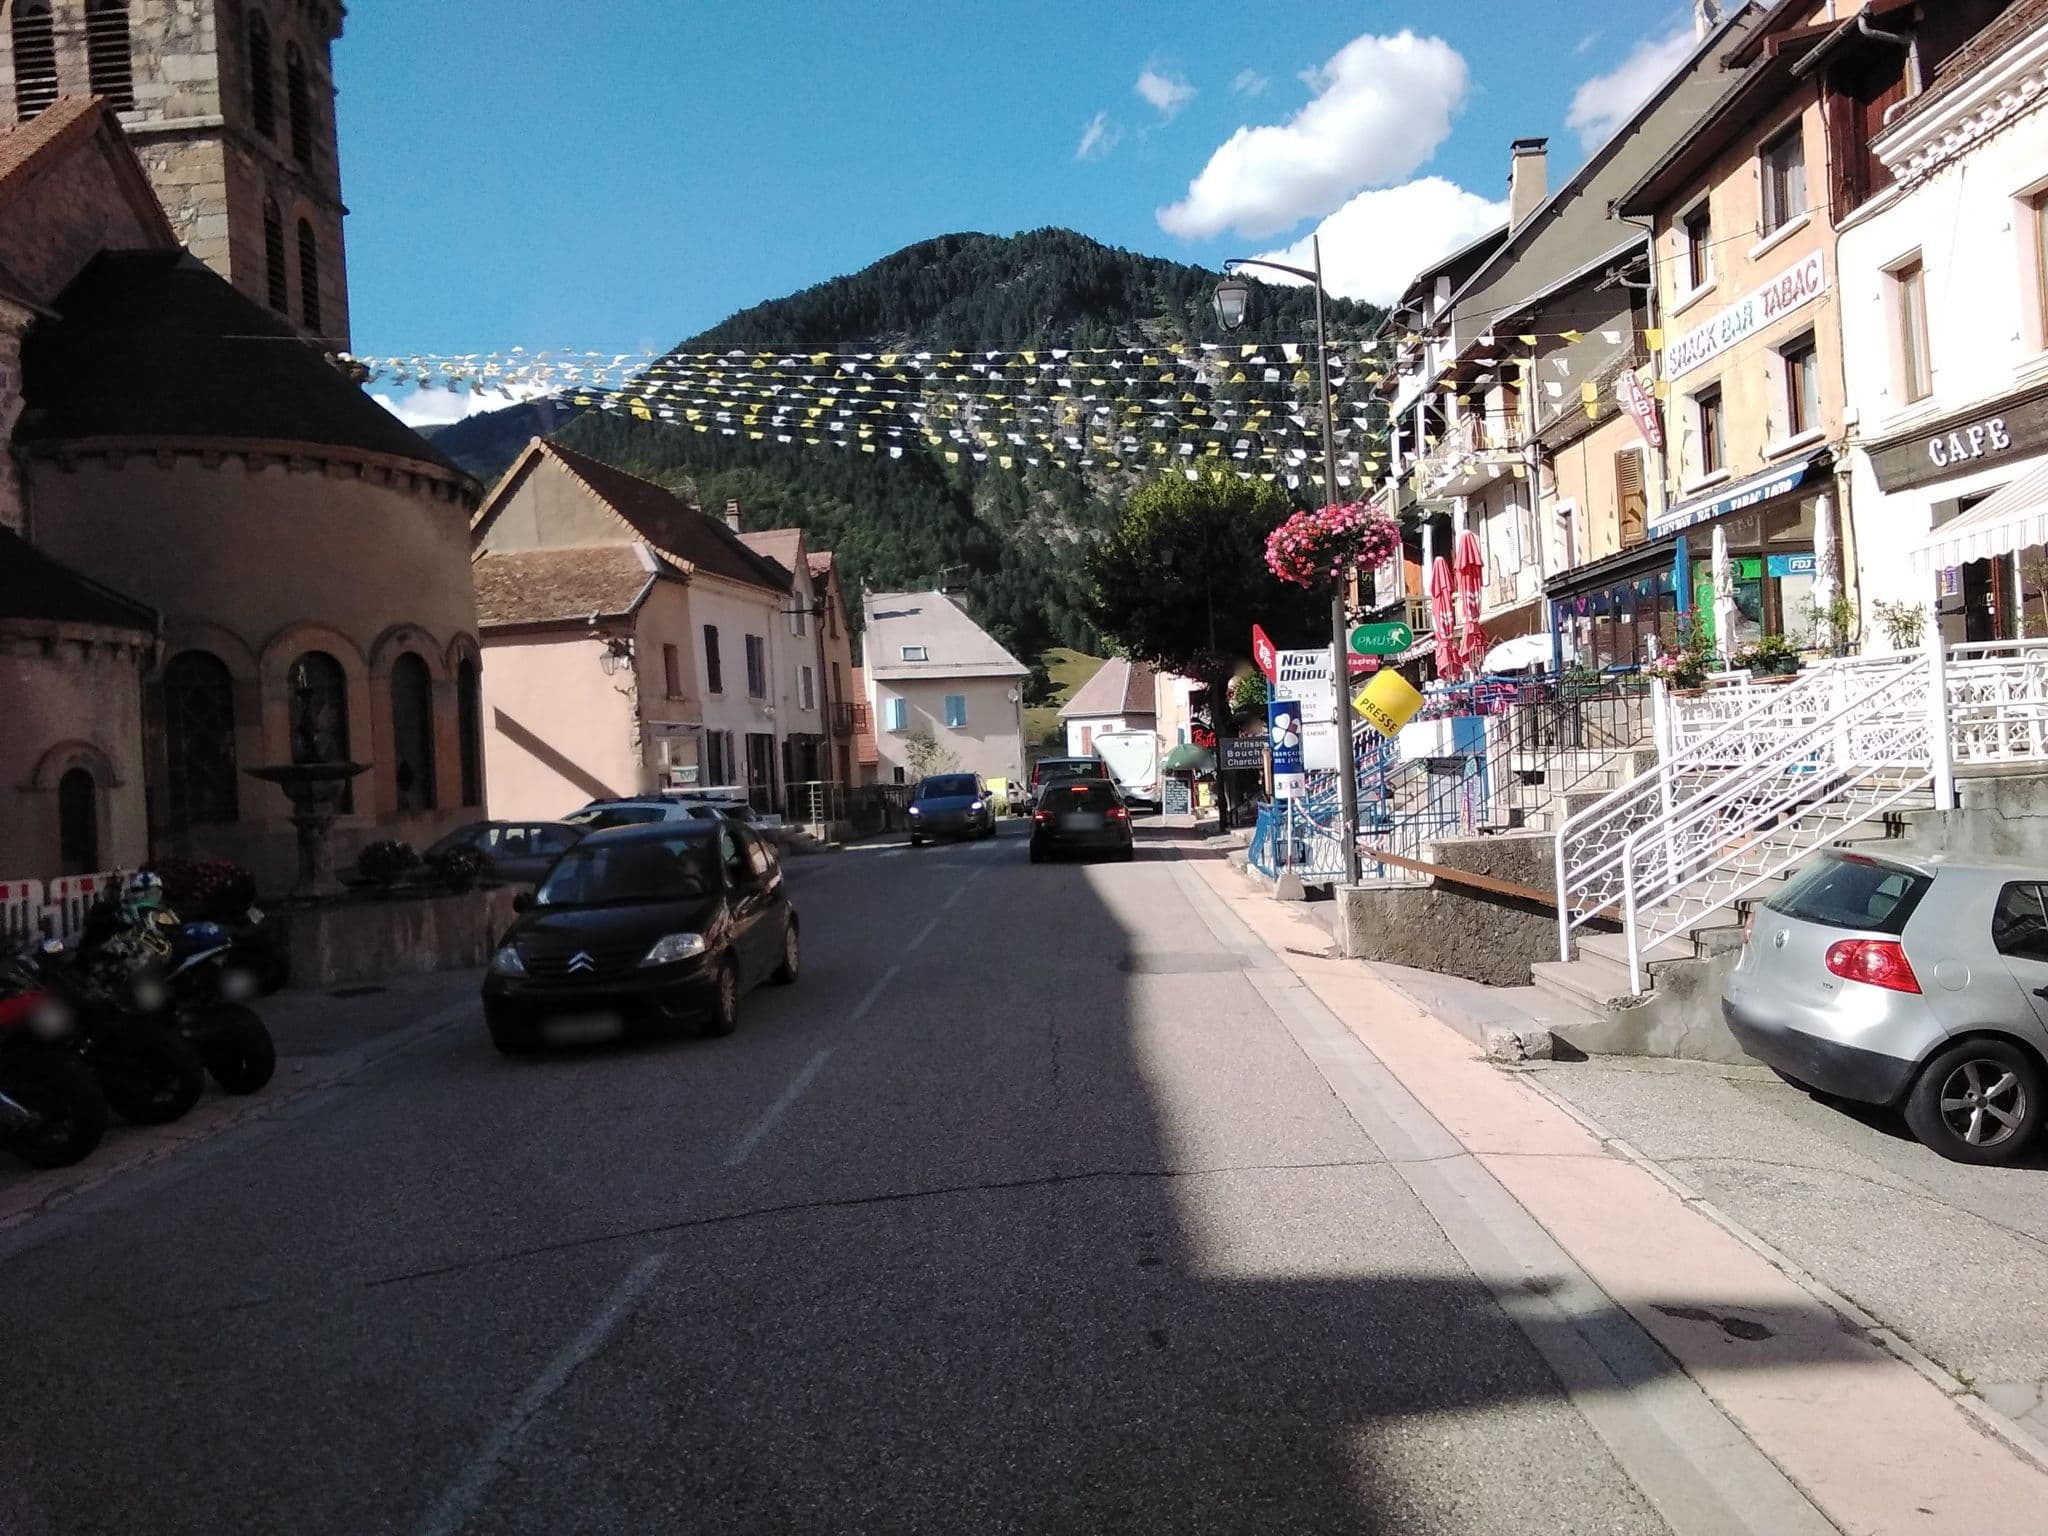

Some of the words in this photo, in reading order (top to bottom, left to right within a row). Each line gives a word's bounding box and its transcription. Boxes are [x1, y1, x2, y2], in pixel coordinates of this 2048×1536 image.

[1669, 322, 1718, 375] SNACK
[1721, 301, 1754, 343] BAR
[1760, 259, 1817, 318] TABAC
[1623, 370, 1661, 444] TABAC
[1928, 418, 2010, 467] CAFE
[1357, 636, 1385, 646] PMU
[1280, 668, 1327, 681] Obiou
[1281, 654, 1318, 666] New
[1360, 698, 1397, 733] PRESSE
